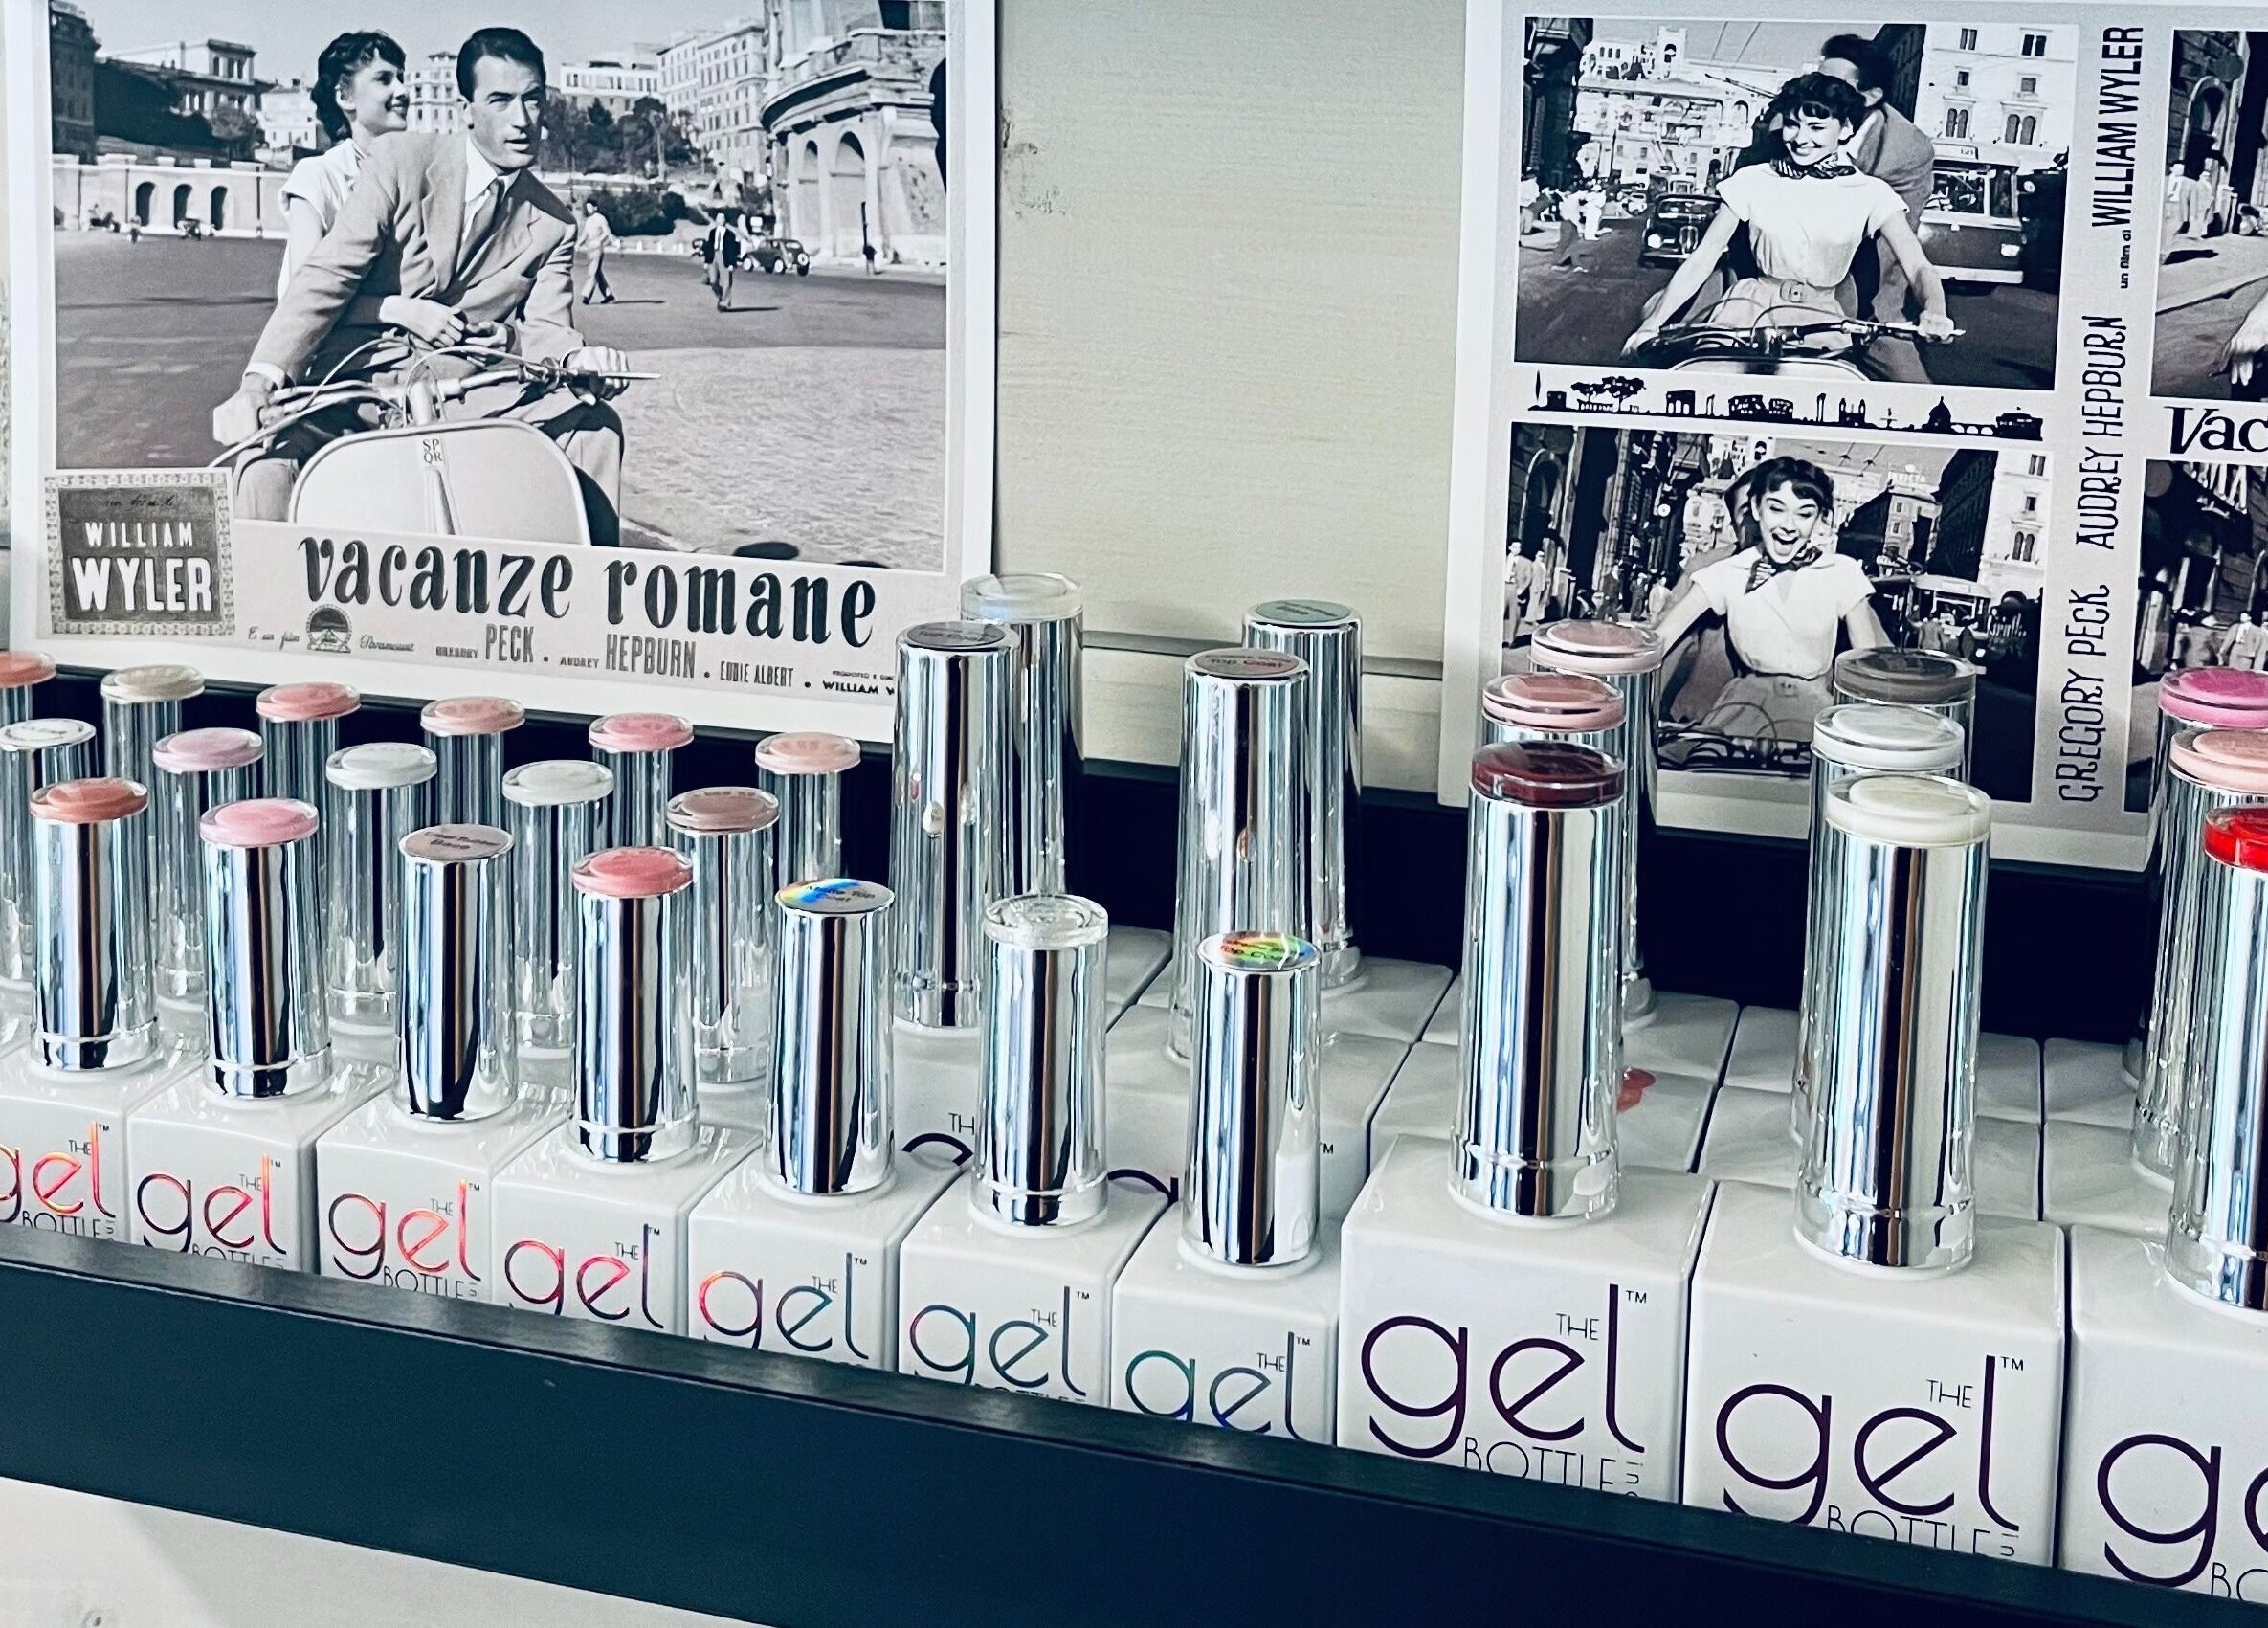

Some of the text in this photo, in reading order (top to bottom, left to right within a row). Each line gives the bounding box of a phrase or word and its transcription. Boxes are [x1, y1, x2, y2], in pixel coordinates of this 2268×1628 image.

[2098, 27, 2144, 115] WYLER
[2091, 122, 2138, 227] WILLIAM
[2075, 315, 2126, 550] AUDREY HEPBURN
[84, 521, 193, 547] WILLIAM
[71, 557, 212, 612] WYLER
[298, 536, 876, 648] vacanze romane
[485, 623, 535, 663] PECK
[560, 655, 599, 669] AUDREY
[606, 634, 697, 679] HEPBURN
[720, 661, 749, 684] EDDIE
[753, 662, 794, 687] ALBERT
[822, 680, 879, 695] WILLIAM
[2055, 584, 2110, 803] GREGORY PECK
[68, 1138, 93, 1155] THE
[948, 1112, 975, 1135] TH
[1319, 1141, 1334, 1155] M
[136, 1153, 287, 1254] gel
[238, 1173, 262, 1193] THE
[430, 1197, 454, 1216] THE
[328, 1178, 482, 1282] gel
[613, 1241, 639, 1260] THE
[503, 1223, 664, 1329] gel
[699, 1252, 869, 1360] gel
[812, 1275, 837, 1294] THE
[909, 1285, 1087, 1396] gel
[1030, 1308, 1058, 1328] THE
[1555, 1312, 1601, 1341] THE
[1125, 1331, 1301, 1439] gel
[1256, 1352, 1286, 1372] THE
[1361, 1283, 1645, 1459] gel
[1925, 1379, 1974, 1410] THE
[1716, 1355, 2020, 1531] gel
[2097, 1433, 2268, 1589] g
